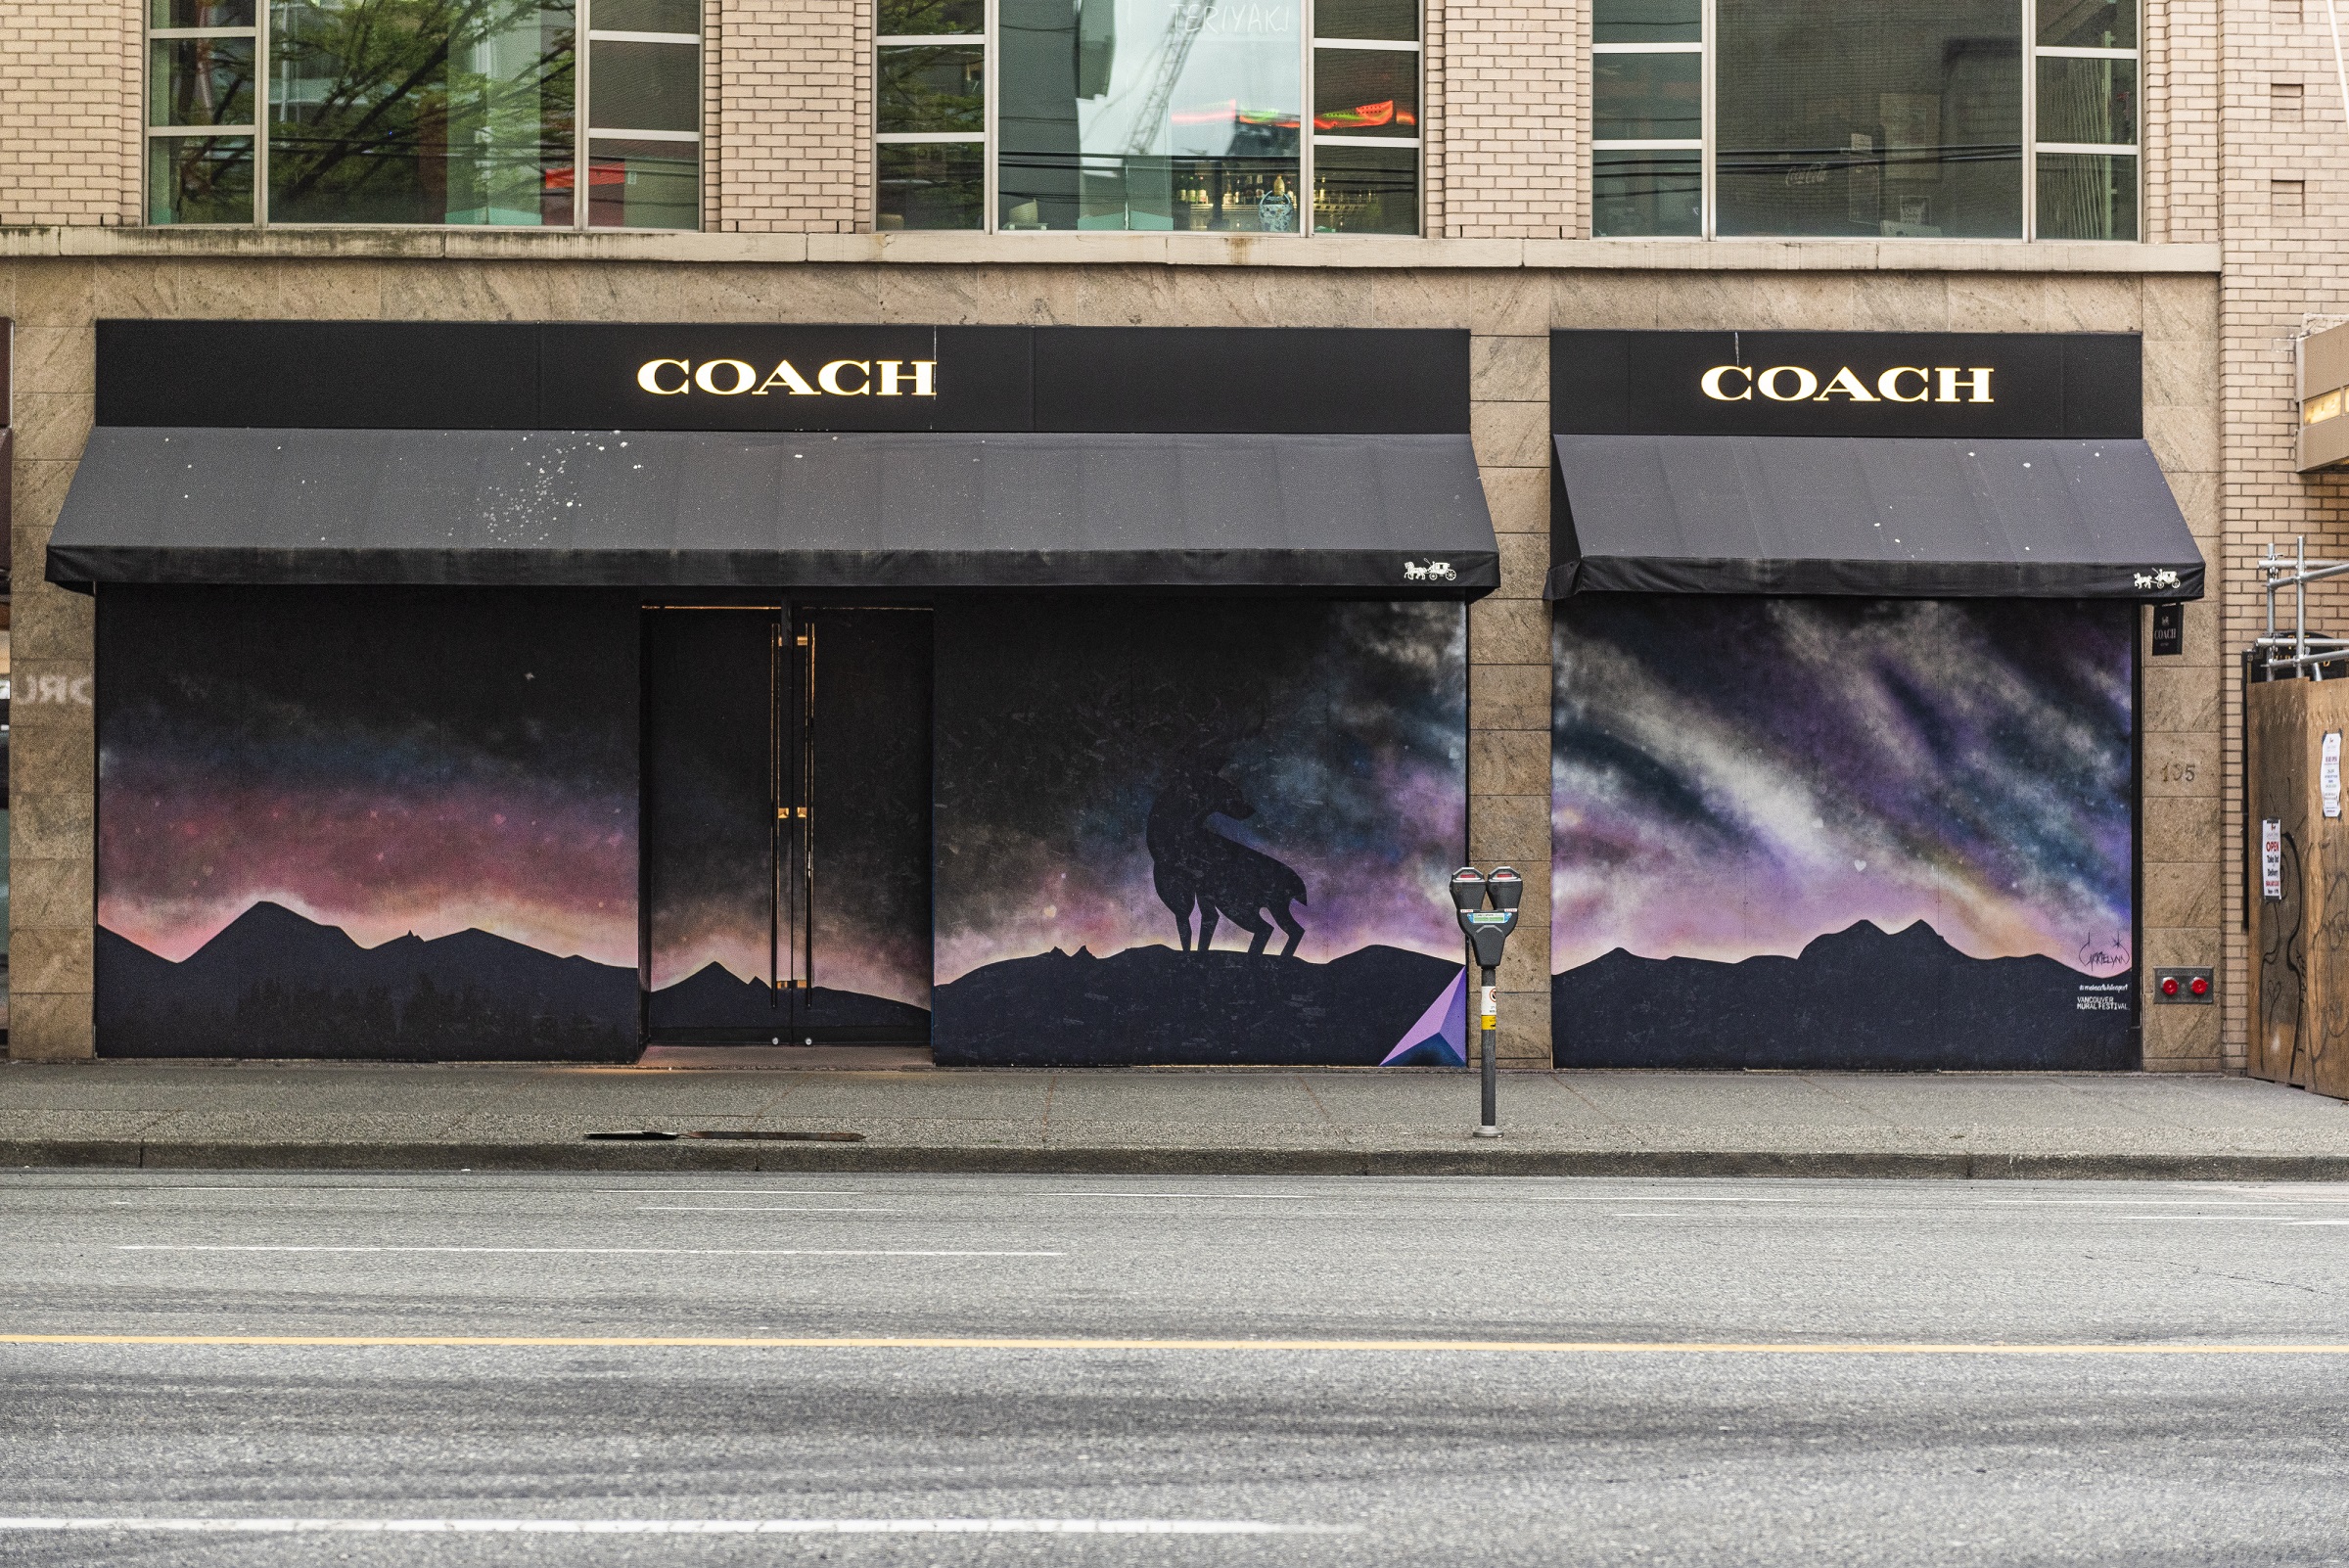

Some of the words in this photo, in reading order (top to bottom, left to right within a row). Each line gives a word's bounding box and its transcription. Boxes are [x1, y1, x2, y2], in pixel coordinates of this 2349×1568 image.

[1168, 3, 1290, 34] TERIYAKI
[637, 358, 937, 395] COACH
[1700, 365, 1995, 403] COACH
[2153, 627, 2177, 640] COACH
[2161, 762, 2195, 782] 105
[2265, 841, 2280, 853] OPEN
